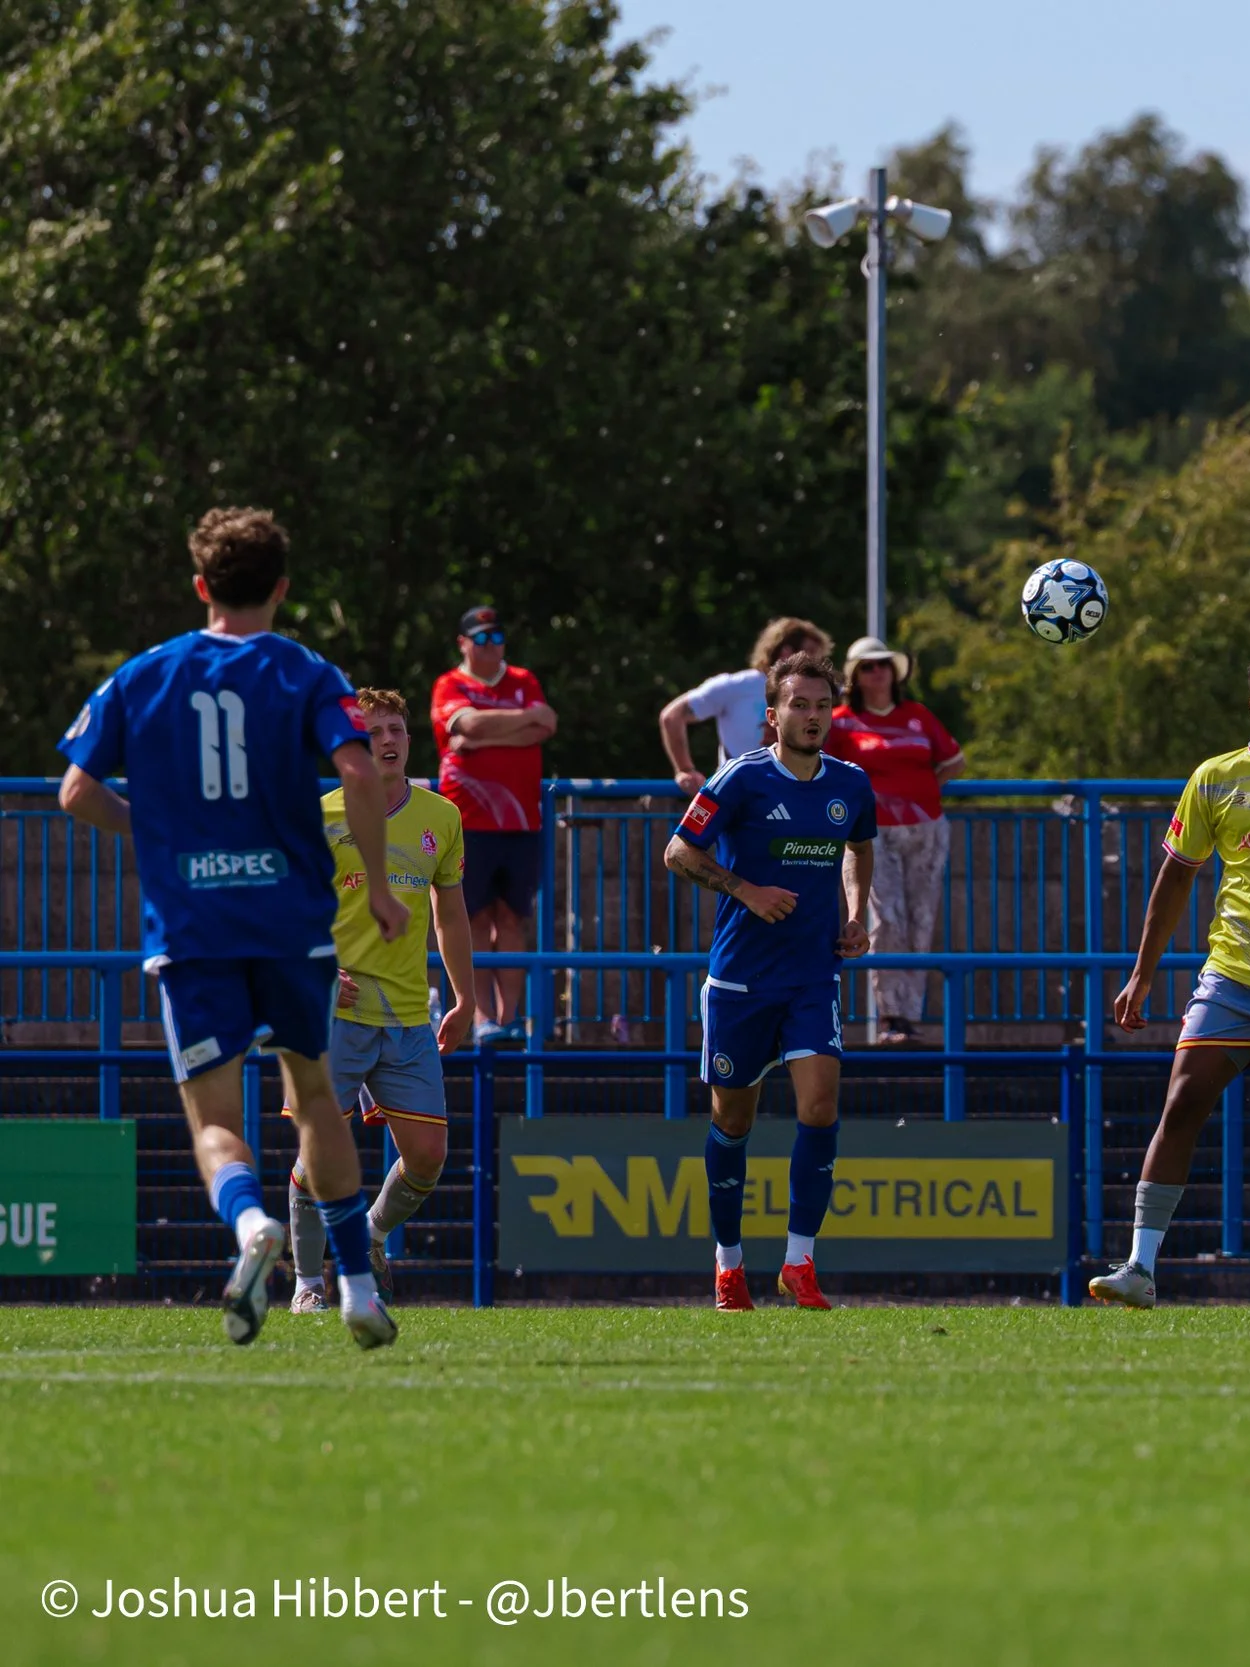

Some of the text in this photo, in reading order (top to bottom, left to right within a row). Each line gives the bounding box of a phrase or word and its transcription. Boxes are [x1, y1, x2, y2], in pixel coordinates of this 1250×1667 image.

[191, 690, 249, 800] 11
[782, 842, 837, 856] Pinnacle
[190, 852, 276, 880] HiSPEC
[342, 871, 366, 890] AF
[511, 1155, 1038, 1237] RNM ELCTRICAL
